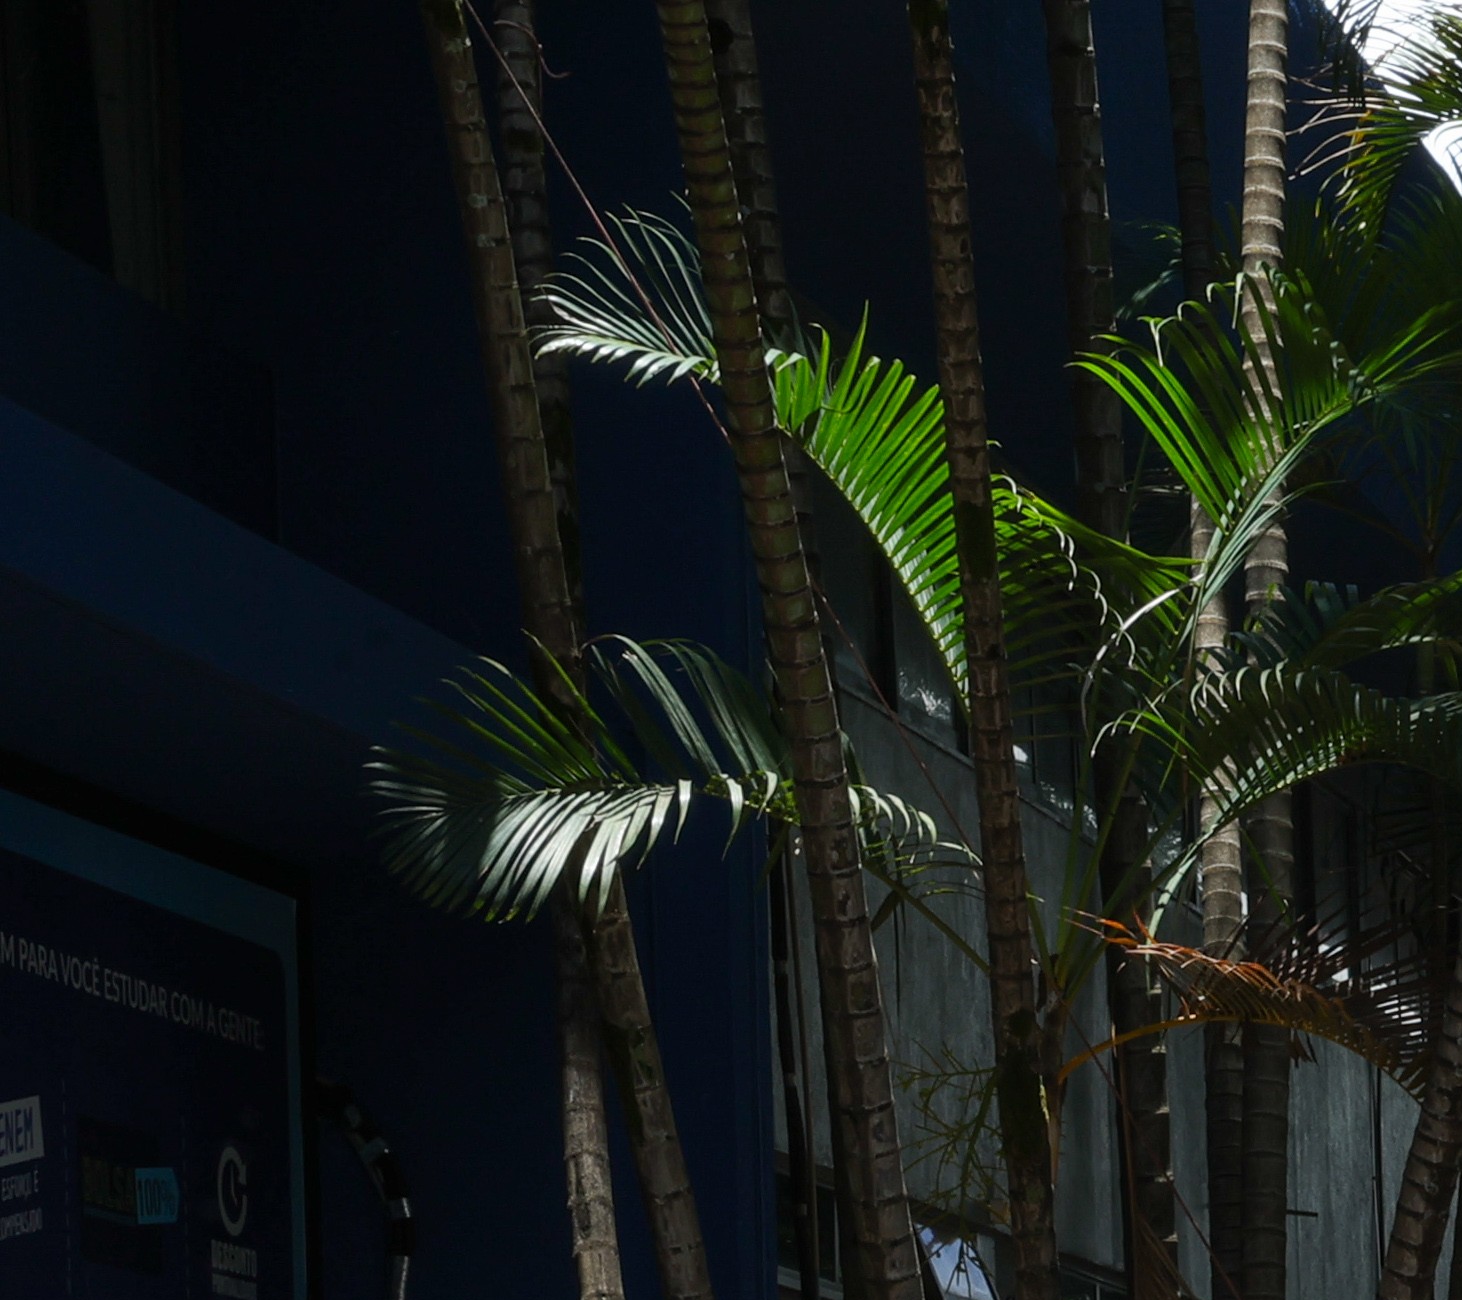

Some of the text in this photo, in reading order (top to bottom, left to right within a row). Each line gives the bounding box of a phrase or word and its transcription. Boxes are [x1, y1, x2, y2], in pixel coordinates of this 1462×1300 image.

[18, 937, 59, 983] PARA
[59, 952, 101, 998] VOCÊ
[103, 967, 169, 1020] ESTUDAR
[169, 990, 204, 1029] COM
